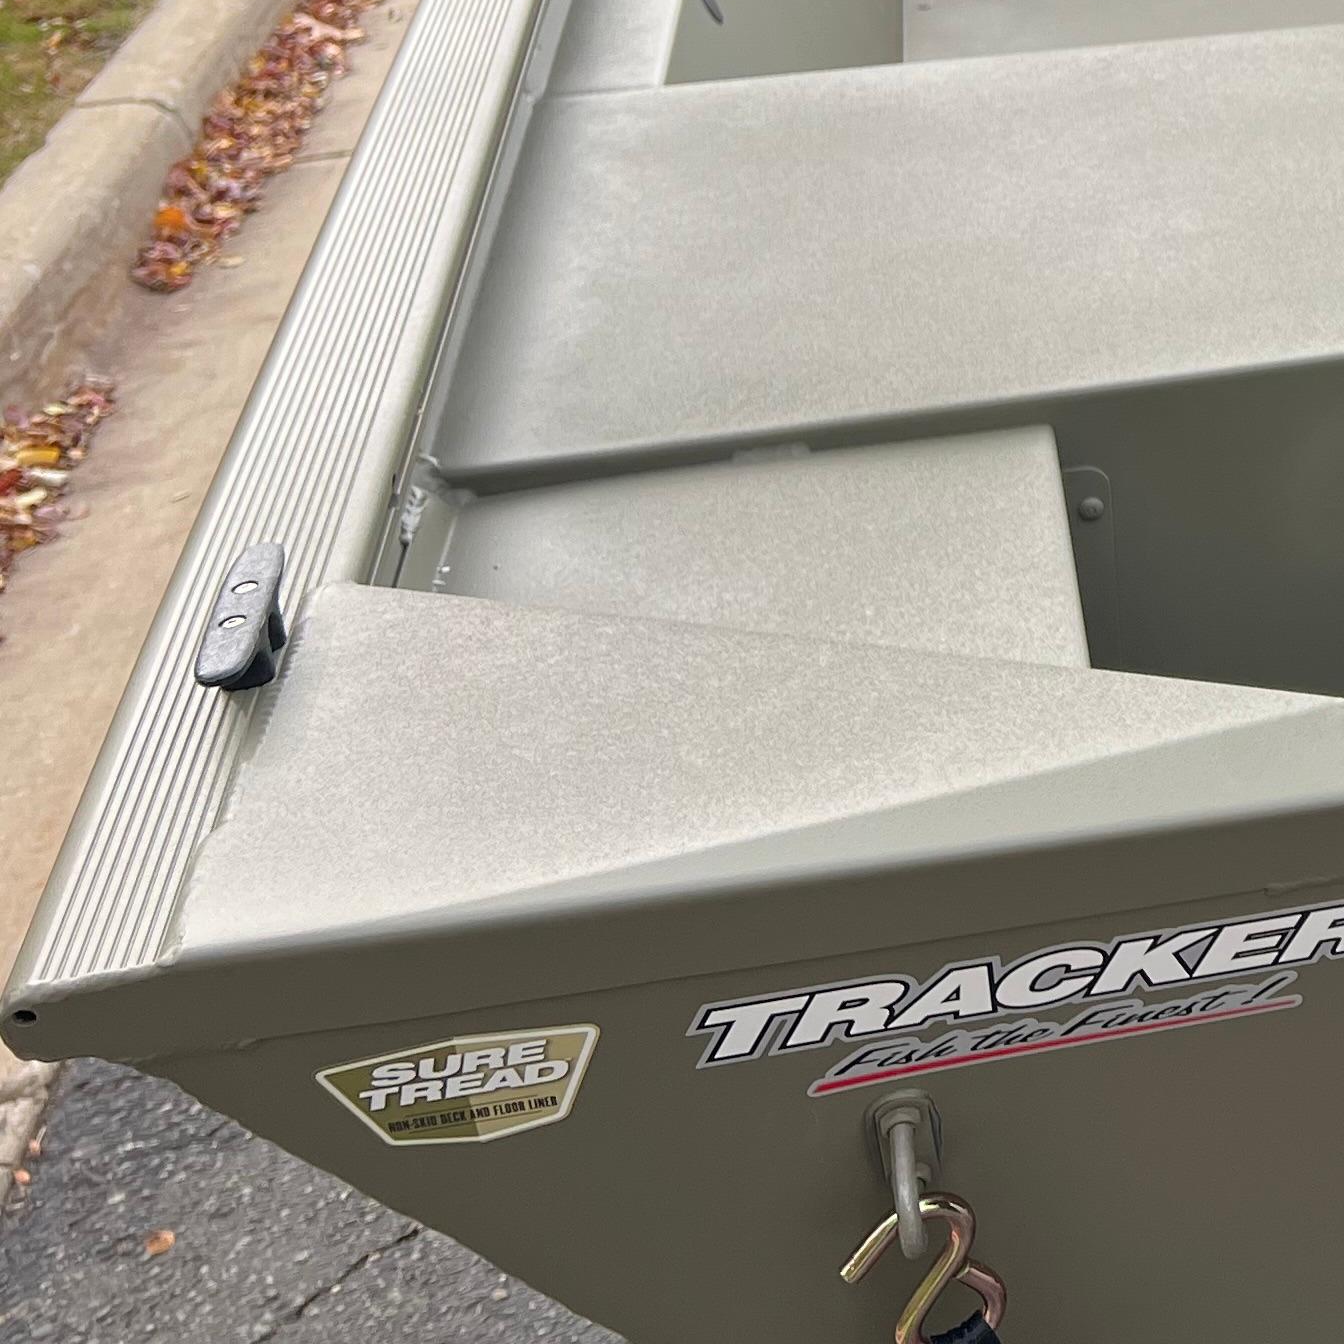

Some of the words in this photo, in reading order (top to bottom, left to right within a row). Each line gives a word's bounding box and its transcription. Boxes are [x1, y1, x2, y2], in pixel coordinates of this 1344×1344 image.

[370, 1039, 547, 1088] SURE
[834, 1033, 958, 1076] Fish
[969, 1025, 1051, 1053] the
[358, 1059, 571, 1112] TREAD
[469, 1106, 491, 1121] AND
[493, 1100, 526, 1116] FLOOR
[528, 1095, 558, 1111] LINER
